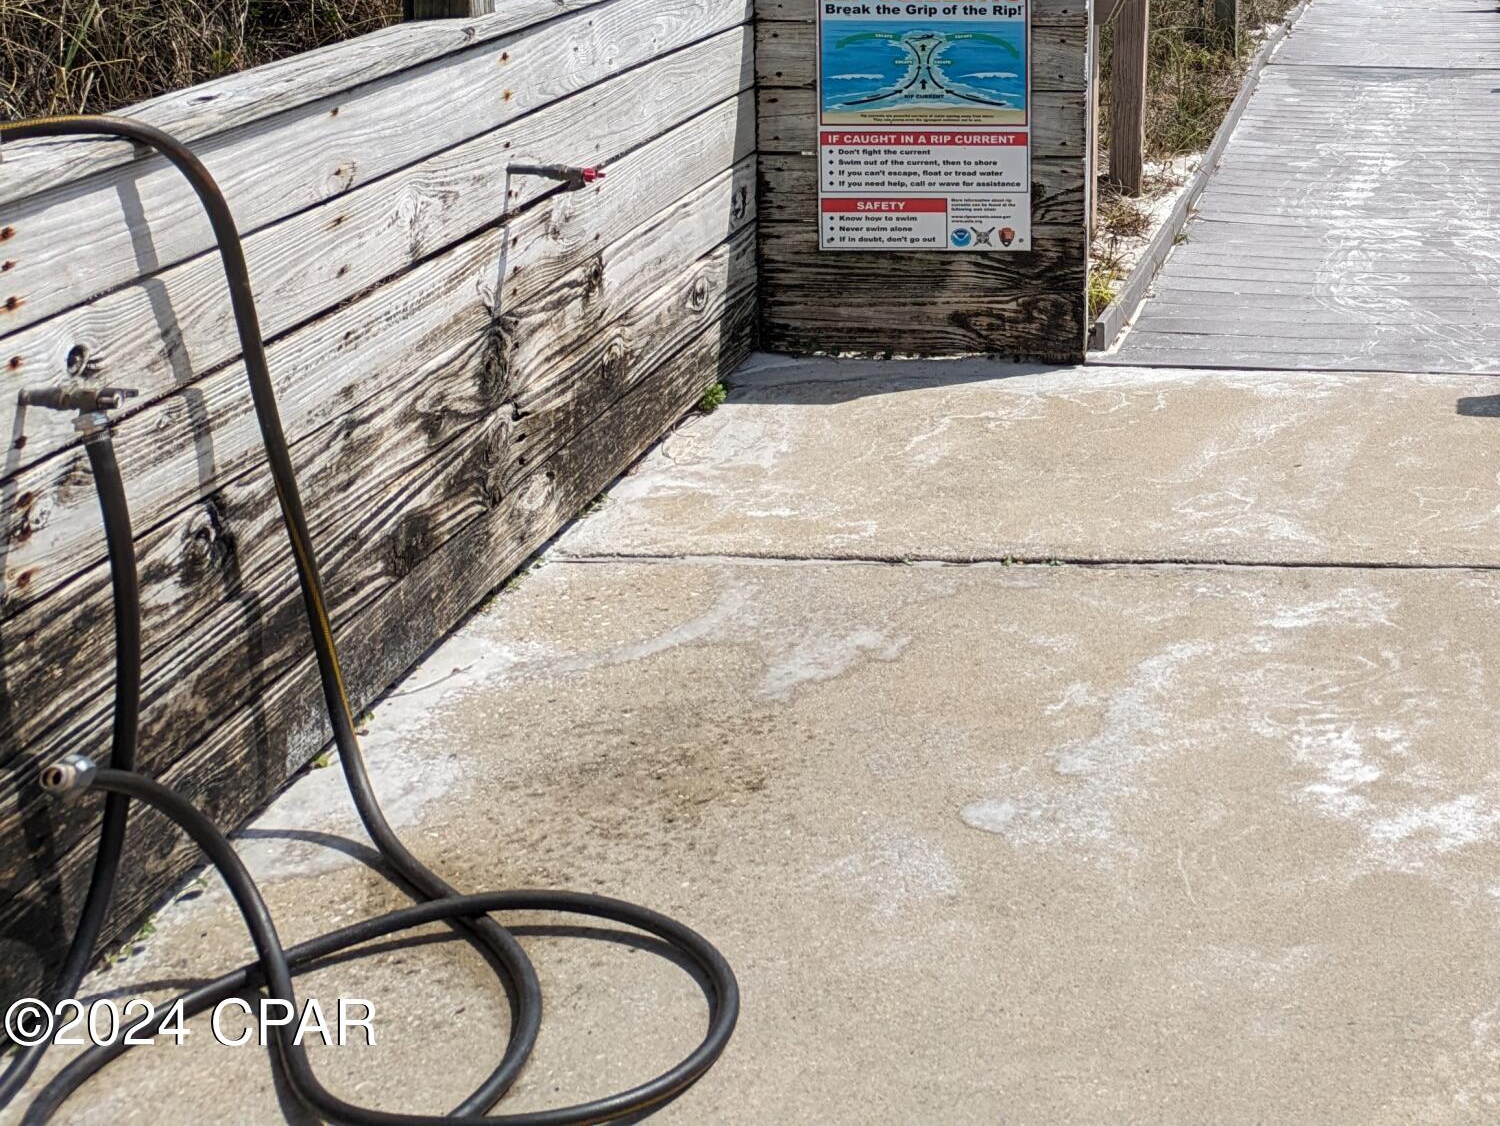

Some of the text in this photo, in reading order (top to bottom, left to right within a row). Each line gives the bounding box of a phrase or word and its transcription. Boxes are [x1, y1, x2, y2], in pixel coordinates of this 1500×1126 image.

[825, 4, 1022, 17] Break the Grip of the Rip!
[828, 135, 1016, 144] IF CAUGHT IN A RIP CURRENT
[857, 201, 905, 210] SAFETY
